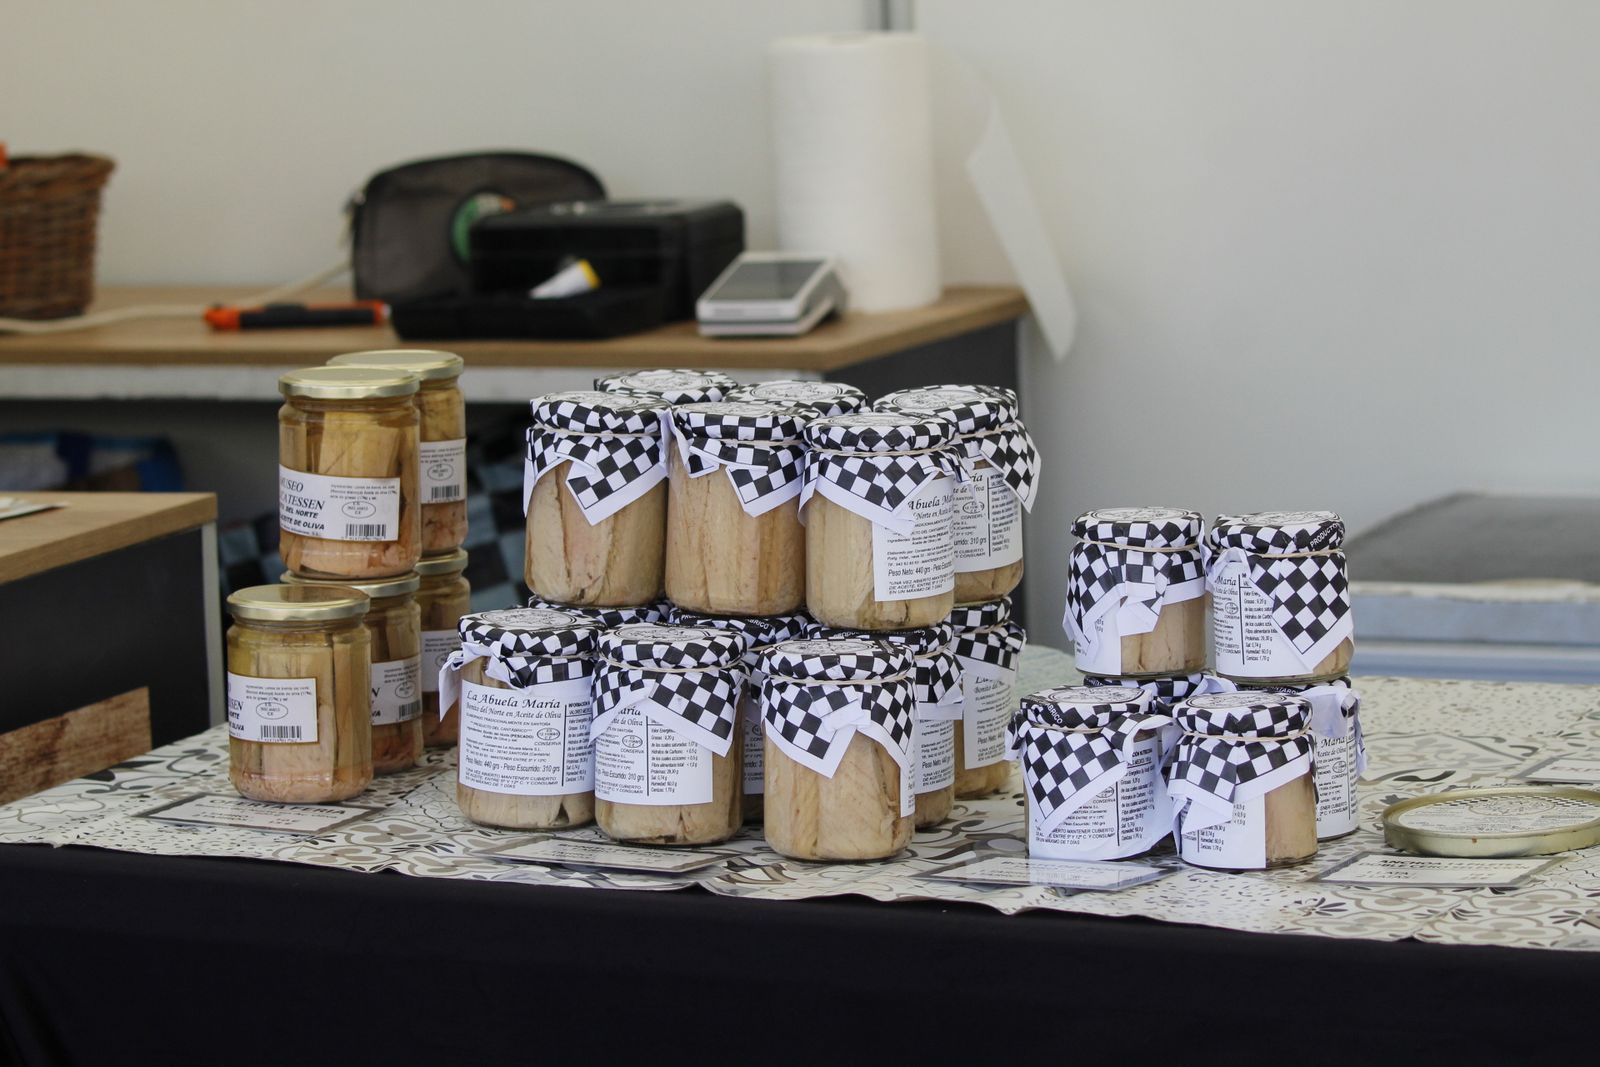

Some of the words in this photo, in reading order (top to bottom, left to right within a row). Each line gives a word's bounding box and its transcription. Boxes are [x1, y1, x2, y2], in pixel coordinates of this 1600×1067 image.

[296, 509, 319, 519] NORTE
[294, 518, 301, 526] DE
[303, 519, 325, 531] OLIVA
[888, 569, 901, 577] Peso
[915, 566, 923, 574] 440
[467, 690, 478, 701] La
[478, 694, 519, 707] Abuela
[522, 699, 561, 709] María
[489, 708, 505, 717] Norte
[536, 711, 543, 719] de
[545, 711, 561, 719] Oliva
[619, 705, 642, 717] aría
[503, 763, 517, 772] Peso
[542, 764, 552, 773] 310
[210, 799, 285, 810] OFERTA
[291, 805, 345, 814] FERIA
